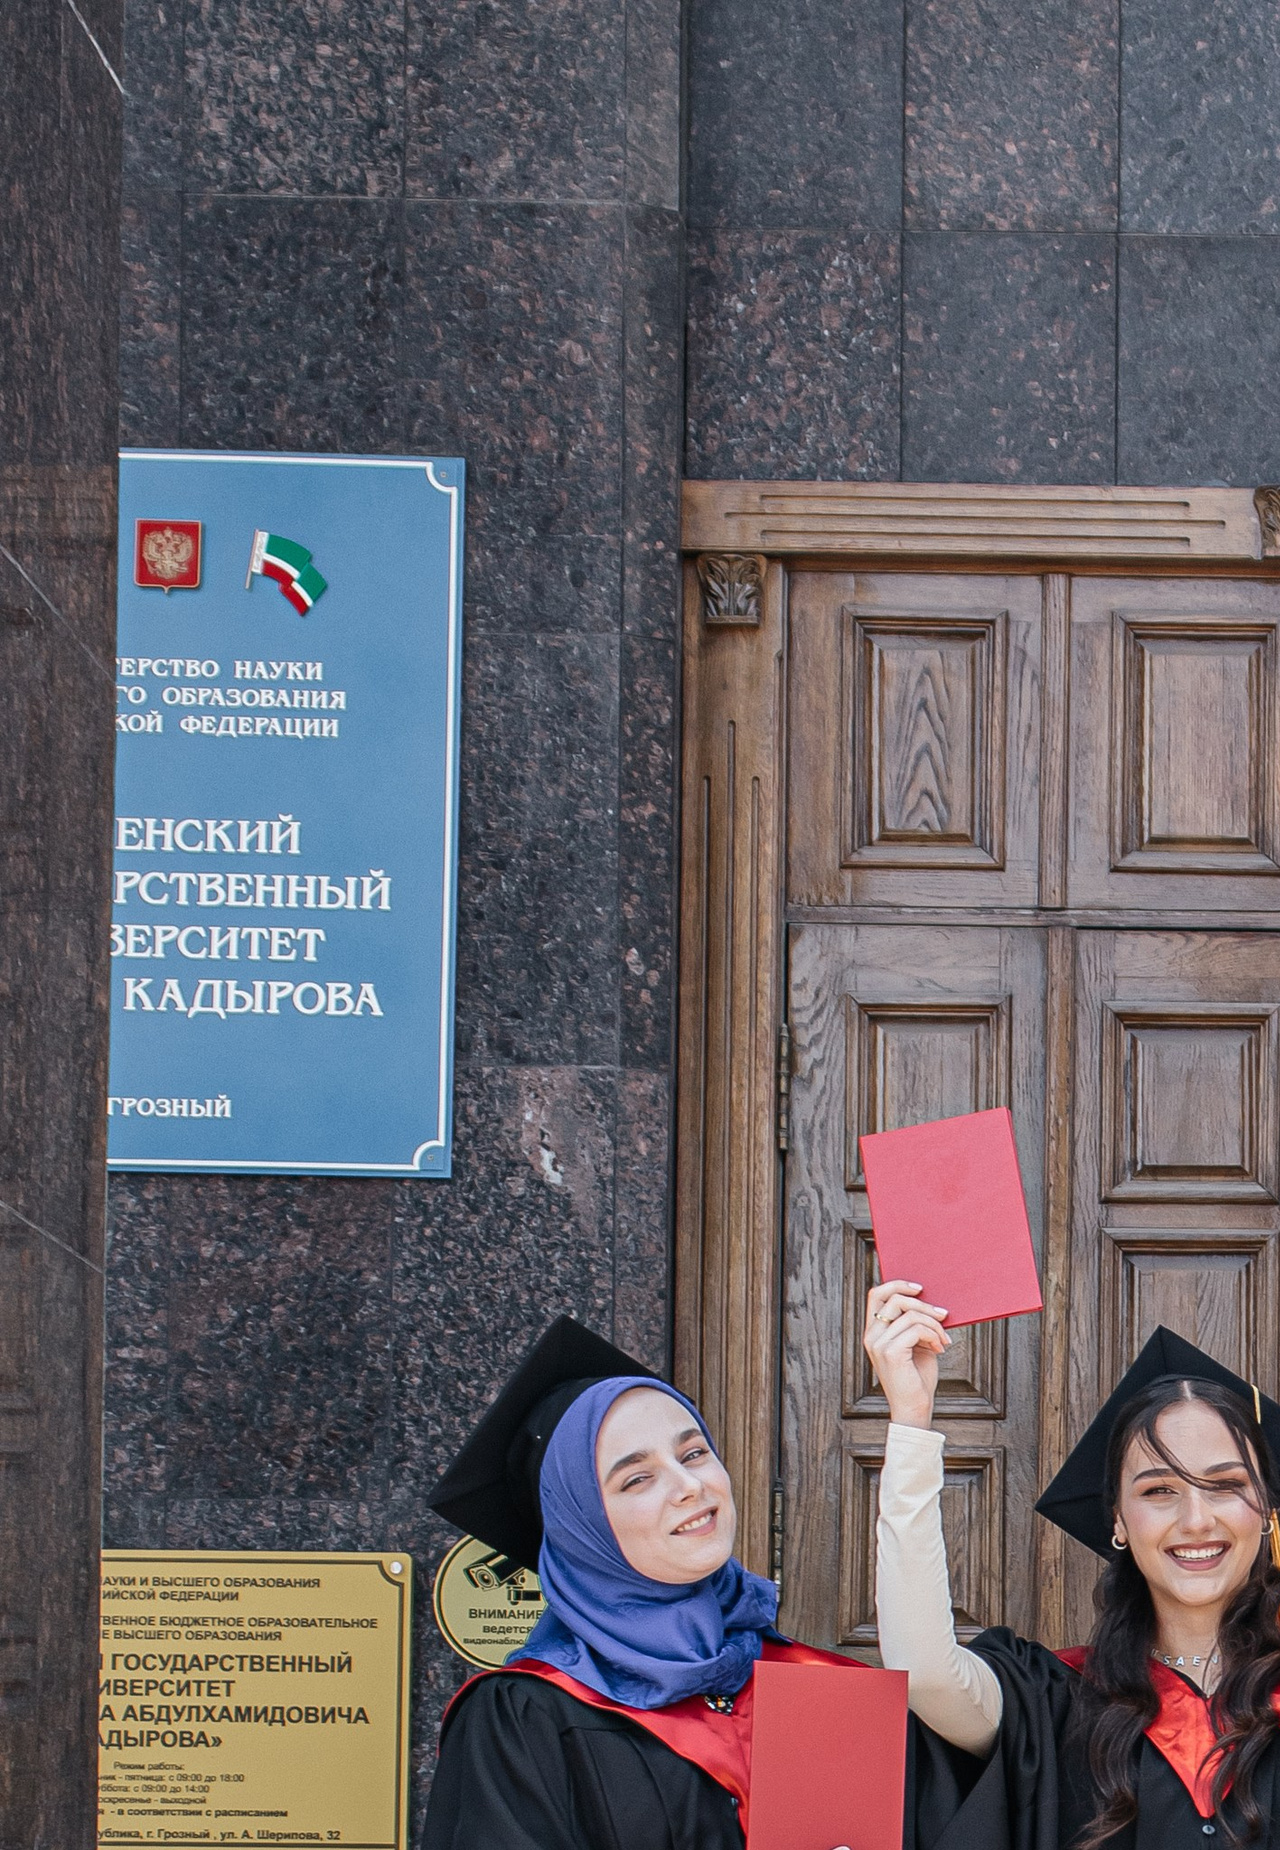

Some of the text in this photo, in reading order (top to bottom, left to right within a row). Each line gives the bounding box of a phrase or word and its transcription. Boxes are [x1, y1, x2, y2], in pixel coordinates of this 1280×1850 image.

[115, 658, 323, 681] ЕРСТВО НАУКИ
[162, 687, 347, 710] ОБРАЗОВАНИЯ
[179, 715, 340, 740] ФЕДЕРАЦИИ
[115, 813, 302, 855] ЕНСКИЙ
[113, 869, 392, 911] РСТВЕННЫЙ
[122, 977, 384, 1020] КАДЫРОВА
[106, 1094, 232, 1118] ГРОЗНЫЙ
[100, 1576, 320, 1588] АУКИ И ВЫСШЕГО ОБРАЗОВАНИЯ
[159, 1591, 239, 1602] ФЕДЕРАЦИИ
[159, 1616, 244, 1627] БЮДЖЕТНОЕ
[247, 1617, 378, 1628] ОБРАЗОВАТЕЛЬНОЕ
[113, 1630, 181, 1640] ВЫСШЕГО
[185, 1631, 282, 1641] ОБРАЗОВАНИЯ
[111, 1651, 352, 1674] ГОСУДАРСТВЕННЫЙ
[122, 1705, 370, 1726] АБДУЛХАМИДОВИЧА
[147, 1762, 185, 1771] работы:
[176, 1773, 202, 1782] 09:00
[220, 1774, 245, 1783] 18:00
[99, 1784, 130, 1793] ббота:
[141, 1785, 167, 1793] 09:00
[184, 1785, 210, 1793] 14:00
[127, 1808, 203, 1817] соответствии
[214, 1810, 288, 1818] расписанием
[146, 1831, 154, 1839] г.
[219, 1831, 238, 1841] ул.
[240, 1830, 254, 1840] А.
[257, 1830, 322, 1841] Шерипова,
[326, 1831, 341, 1840] 32
